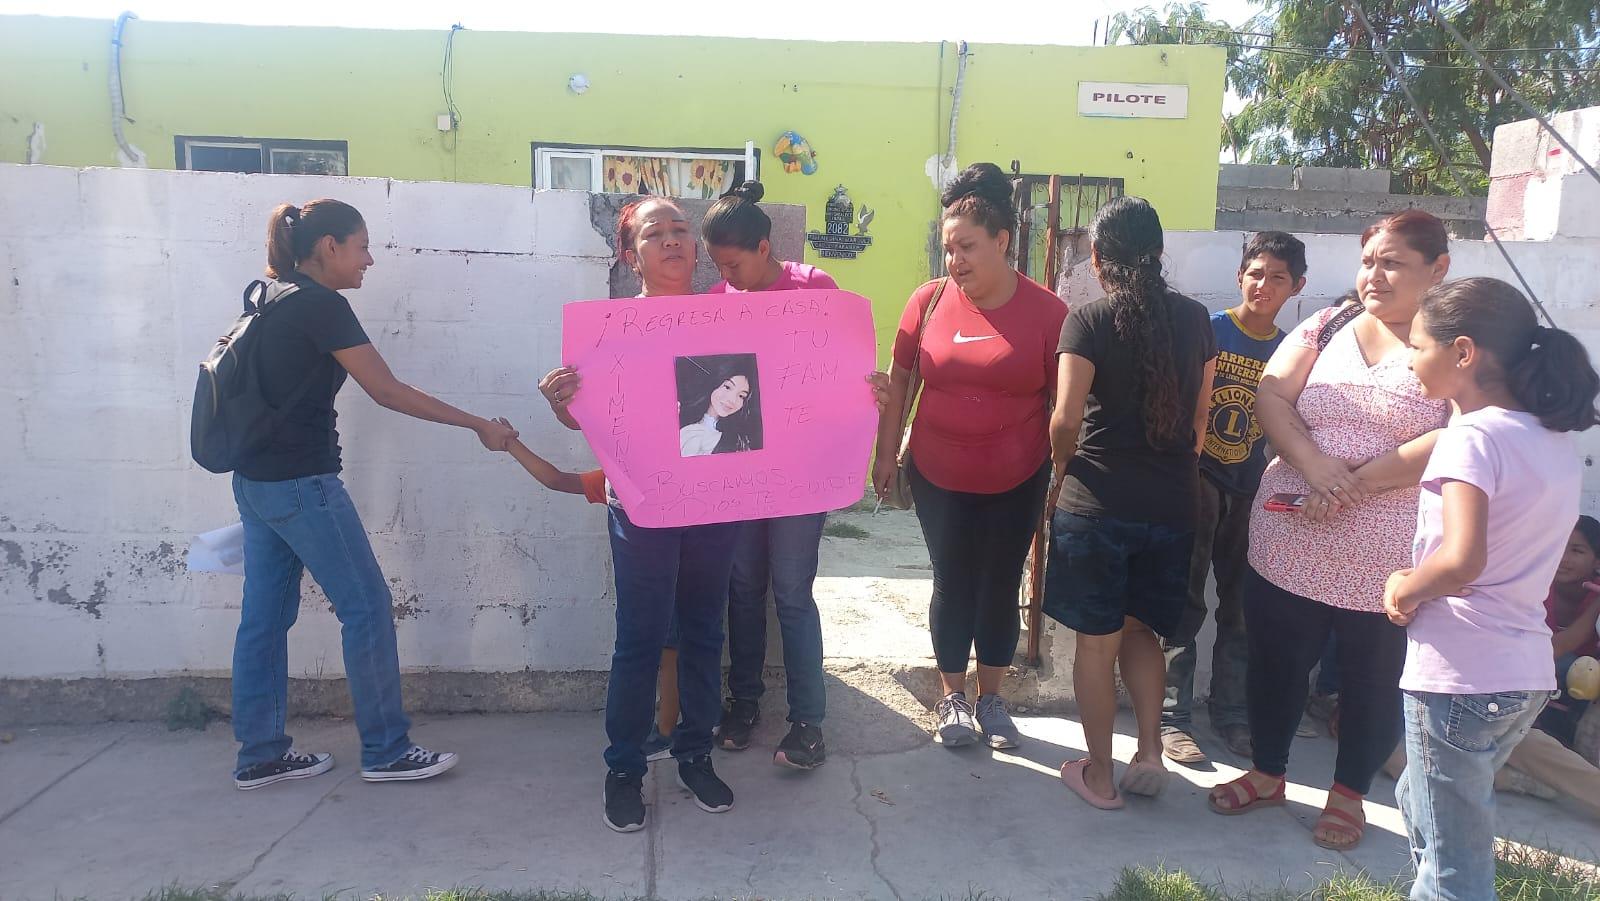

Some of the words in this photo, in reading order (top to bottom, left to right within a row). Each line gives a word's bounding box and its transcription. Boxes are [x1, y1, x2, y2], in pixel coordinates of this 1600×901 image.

[1092, 92, 1167, 105] PILOTE
[827, 222, 849, 234] 2082
[739, 302, 753, 320] A
[765, 295, 830, 317] CASA!
[784, 328, 829, 352] TU
[777, 360, 839, 390] FAM
[1216, 360, 1262, 381] NIVERSA
[1219, 389, 1255, 409] LIONS
[784, 404, 811, 425] TE
[1223, 409, 1242, 438] L
[745, 490, 777, 506] TE
